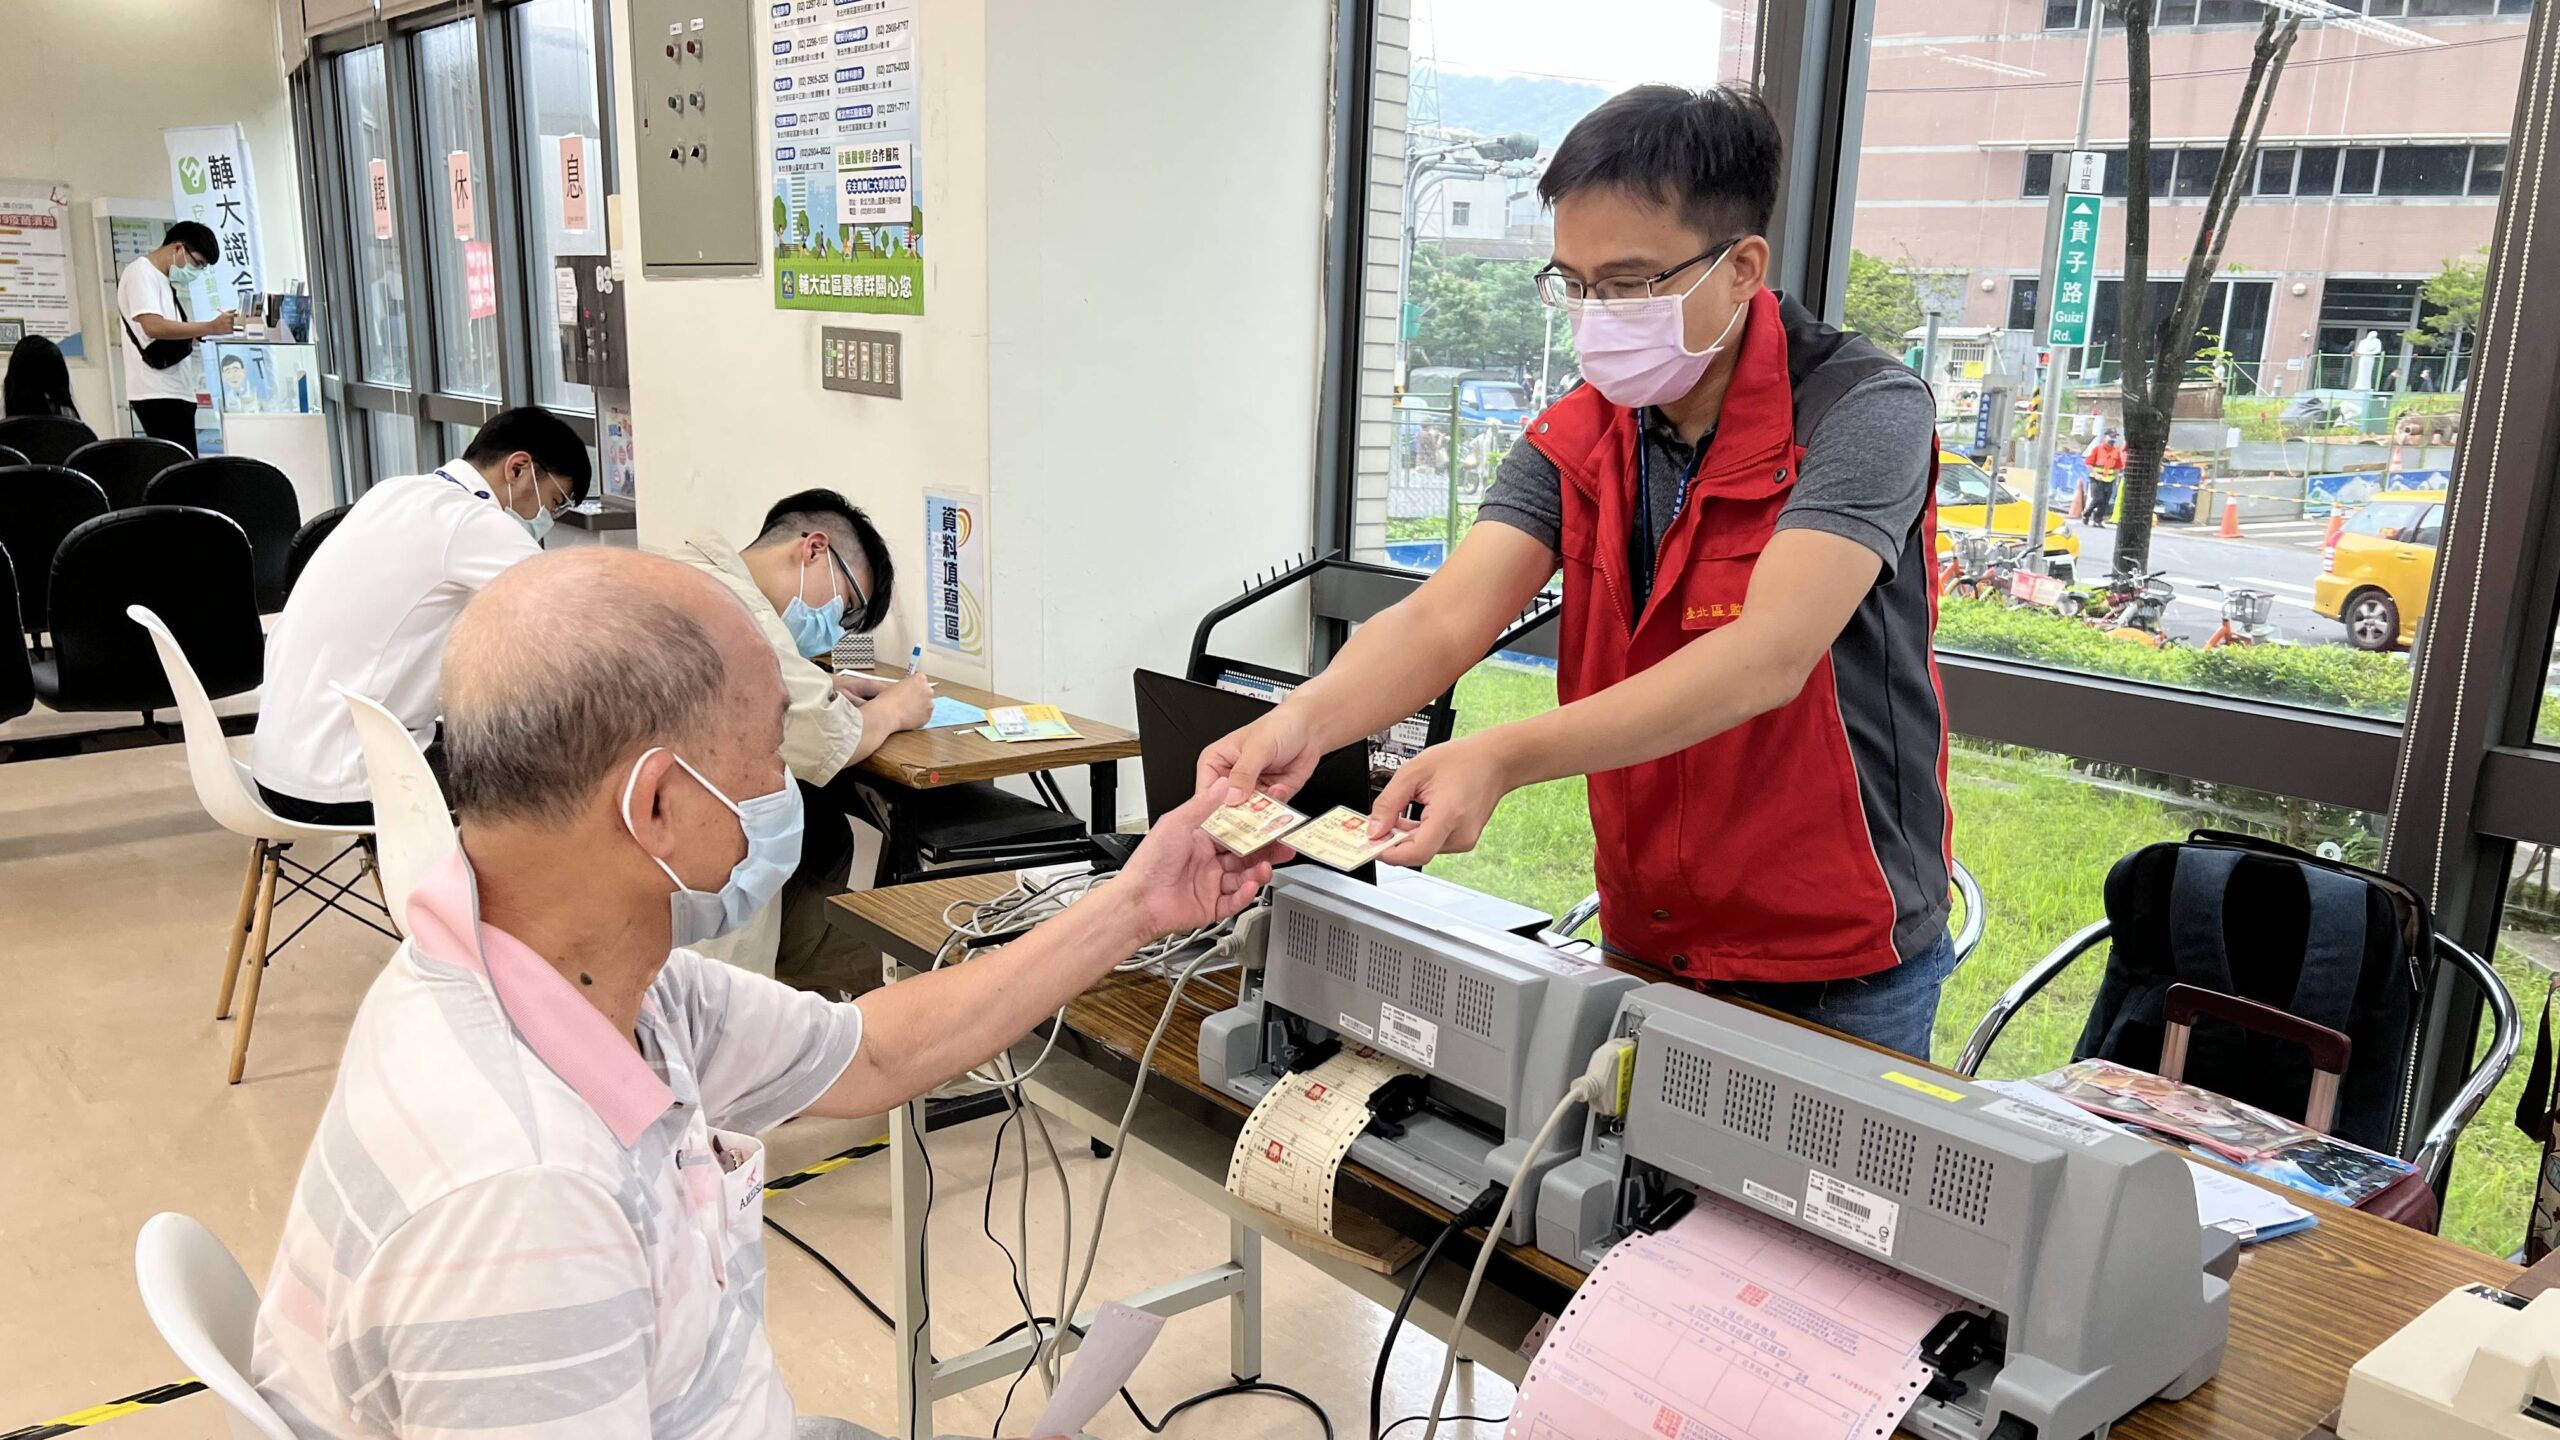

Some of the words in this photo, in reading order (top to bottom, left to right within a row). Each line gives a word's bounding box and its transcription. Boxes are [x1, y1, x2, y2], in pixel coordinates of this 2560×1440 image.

[838, 148, 900, 165] 社區醫療群合作醫院
[2080, 154, 2095, 191] 泰山區
[454, 168, 469, 209] 休
[566, 154, 584, 199] 息
[2061, 219, 2091, 304] 貴子路
[798, 273, 913, 299] 輔大社區醫療群關心您
[2055, 310, 2084, 323] Guizi
[2052, 329, 2072, 342] Rd.
[942, 506, 959, 641] 資料填寫區
